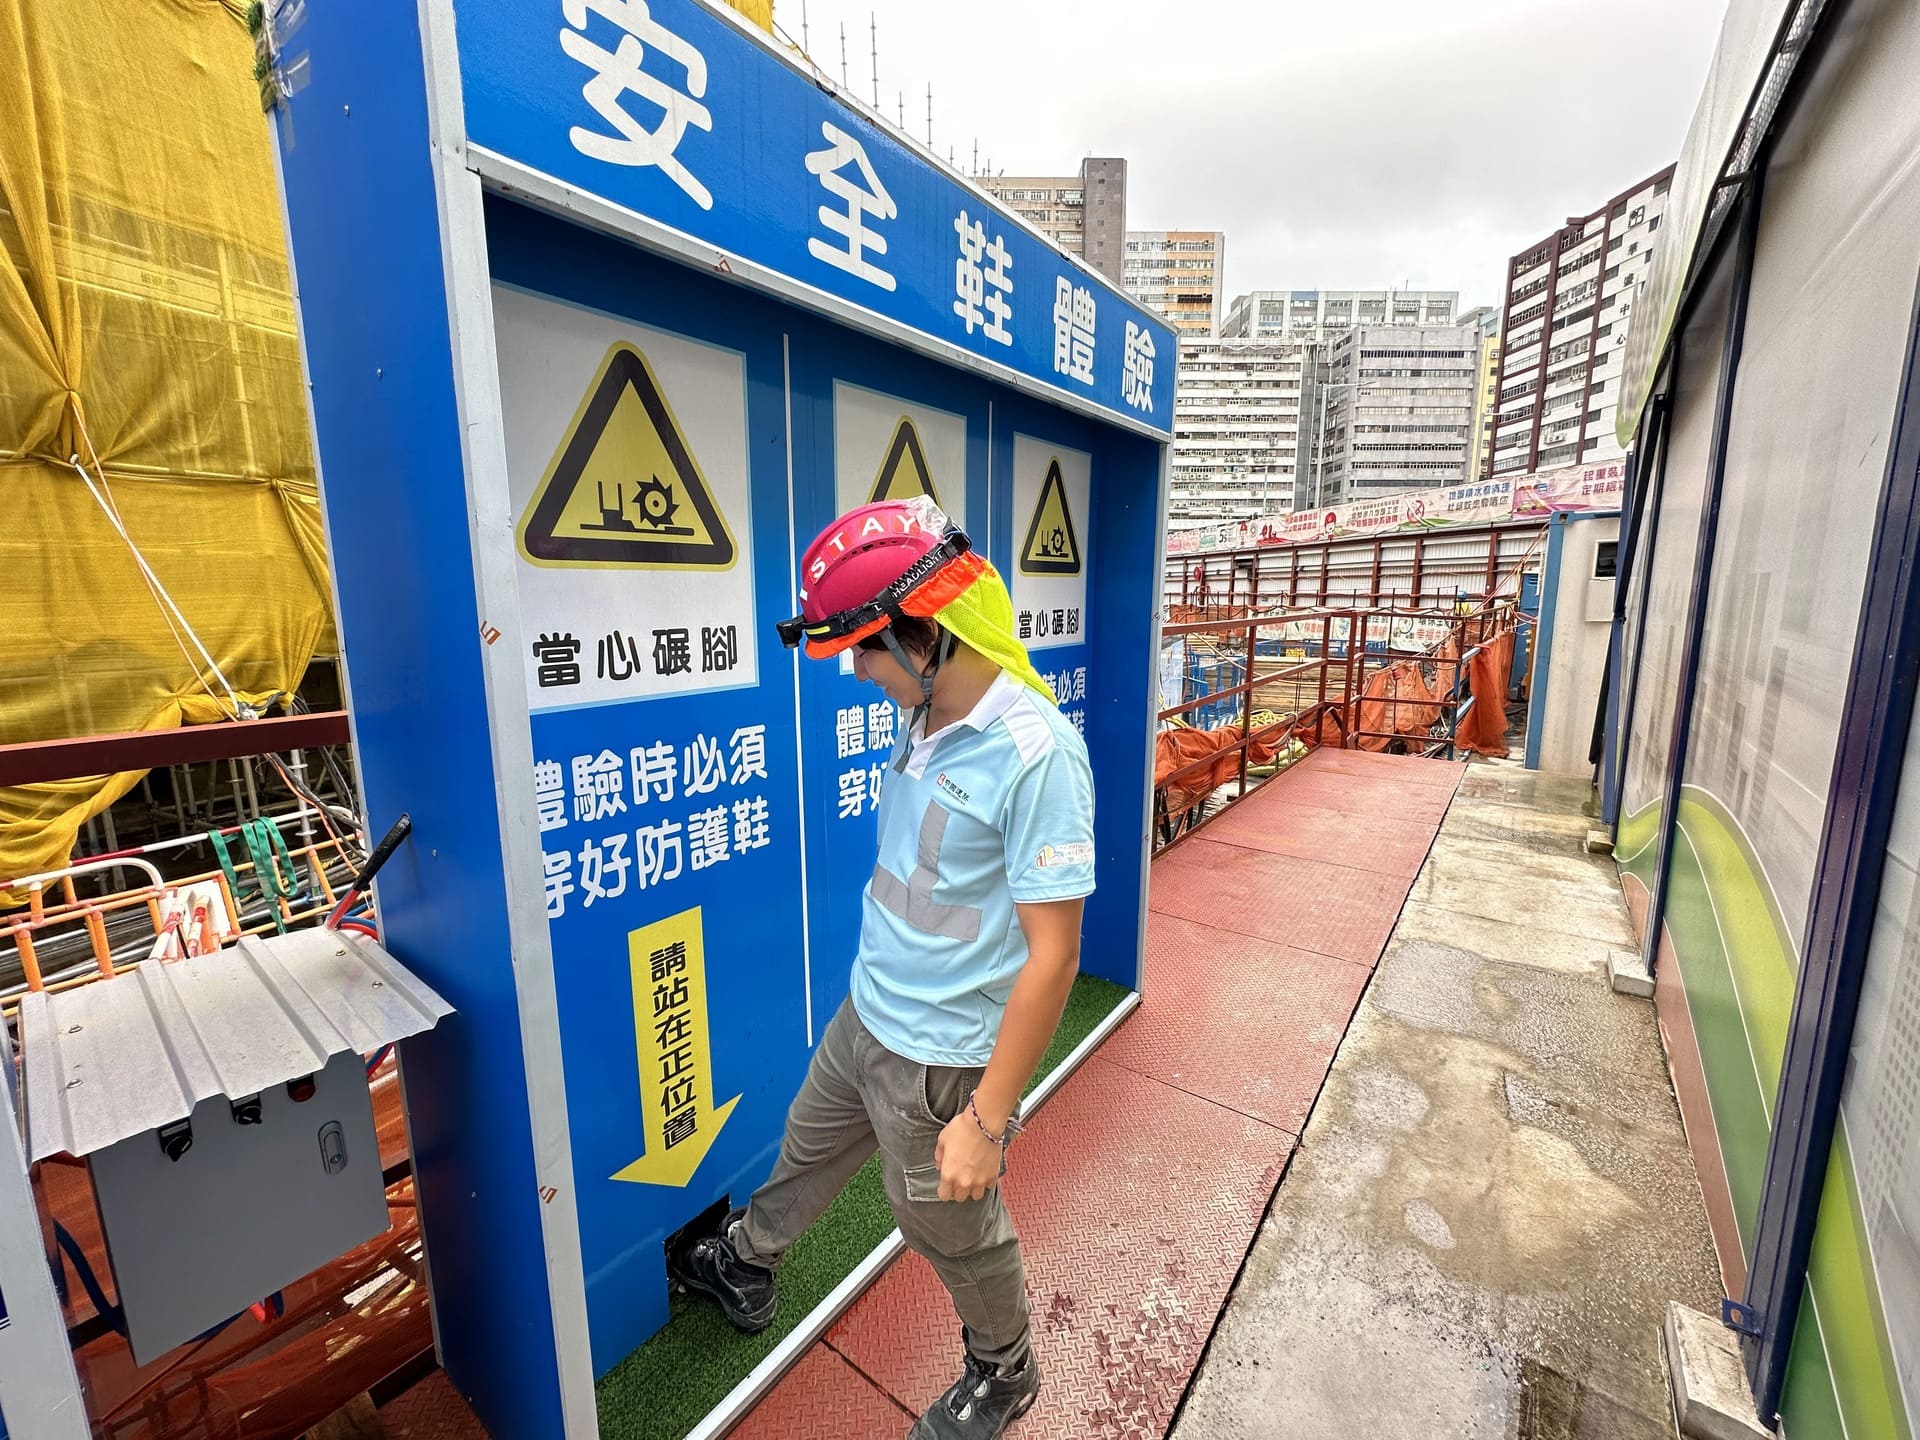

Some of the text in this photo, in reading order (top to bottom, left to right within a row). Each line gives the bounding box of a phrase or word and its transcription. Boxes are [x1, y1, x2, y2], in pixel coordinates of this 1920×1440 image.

[560, 0, 1156, 414] 安全鞋體驗
[811, 514, 917, 580] STAY
[892, 549, 944, 599] HEADLIGHT
[1018, 607, 1080, 640] 當心碾腳
[532, 625, 738, 688] 當心碾腳
[836, 699, 904, 759] 體驗
[649, 940, 698, 1151] 請站在正位置
